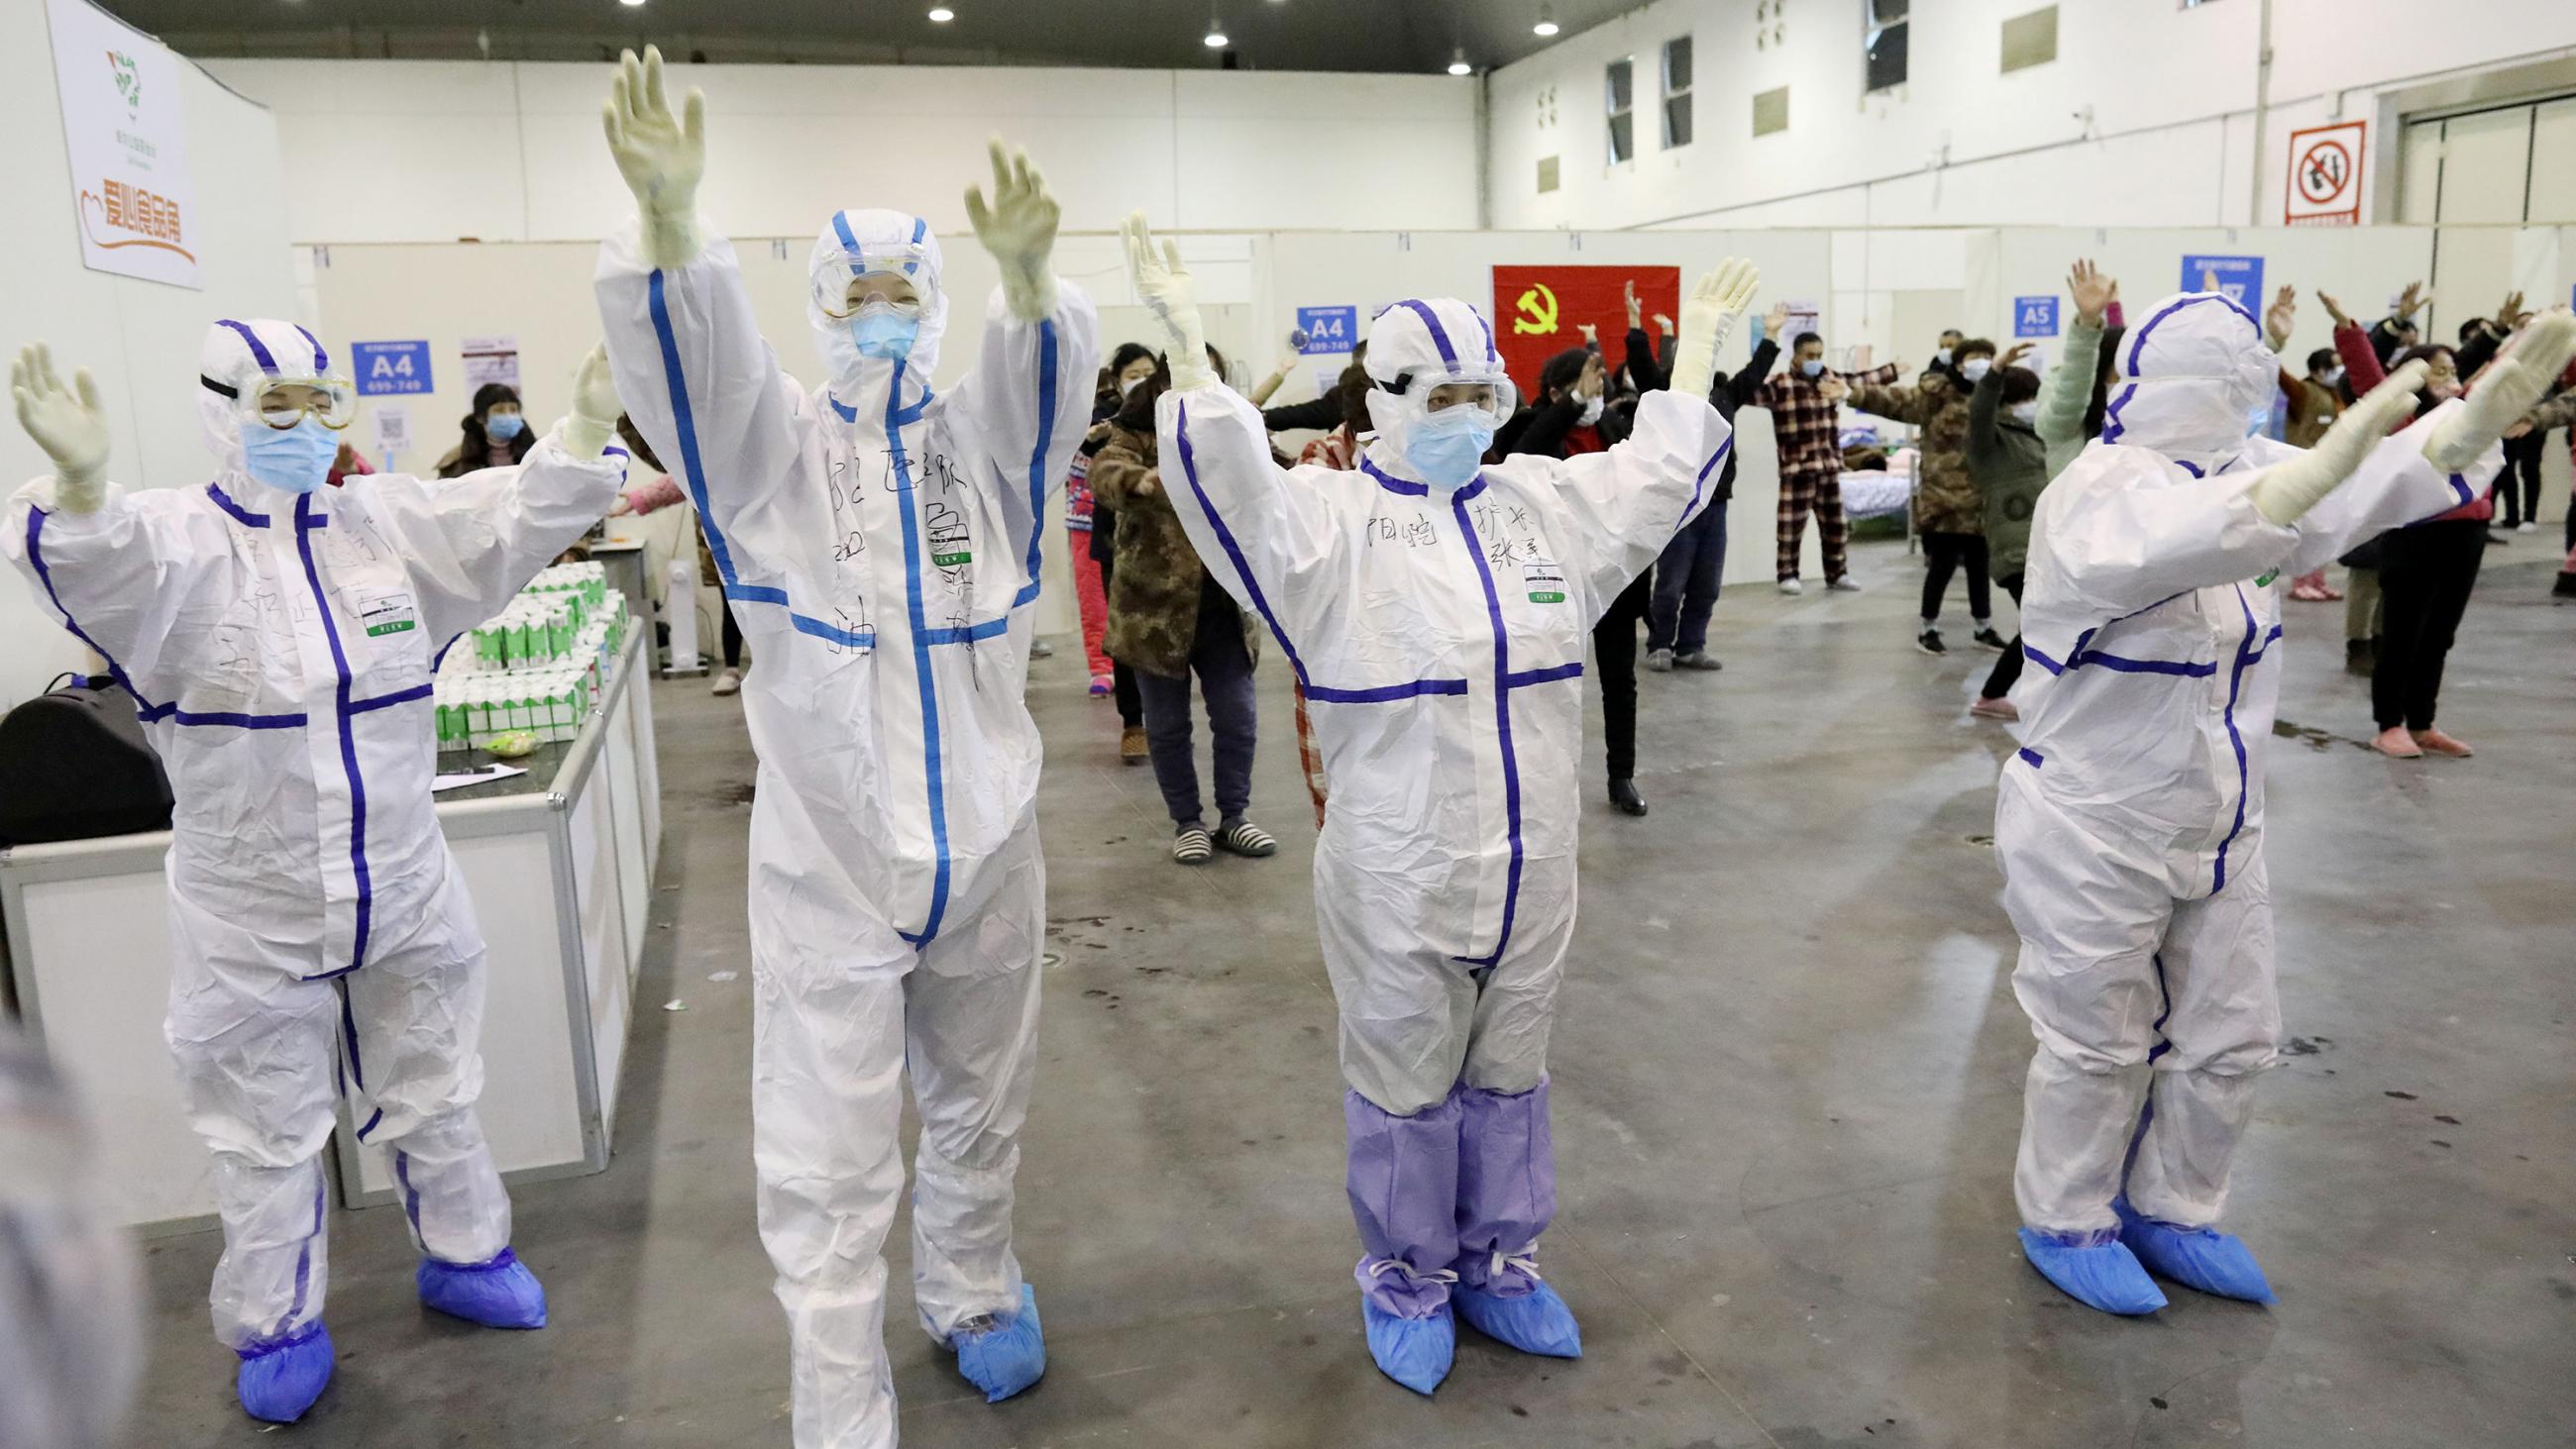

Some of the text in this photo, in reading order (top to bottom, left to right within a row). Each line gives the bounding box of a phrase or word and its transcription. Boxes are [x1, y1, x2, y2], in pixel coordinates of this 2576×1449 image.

[103, 178, 181, 242] 爱心食品角
[2023, 305, 2050, 326] A5
[1311, 318, 1344, 338] A4
[371, 354, 414, 378] A4
